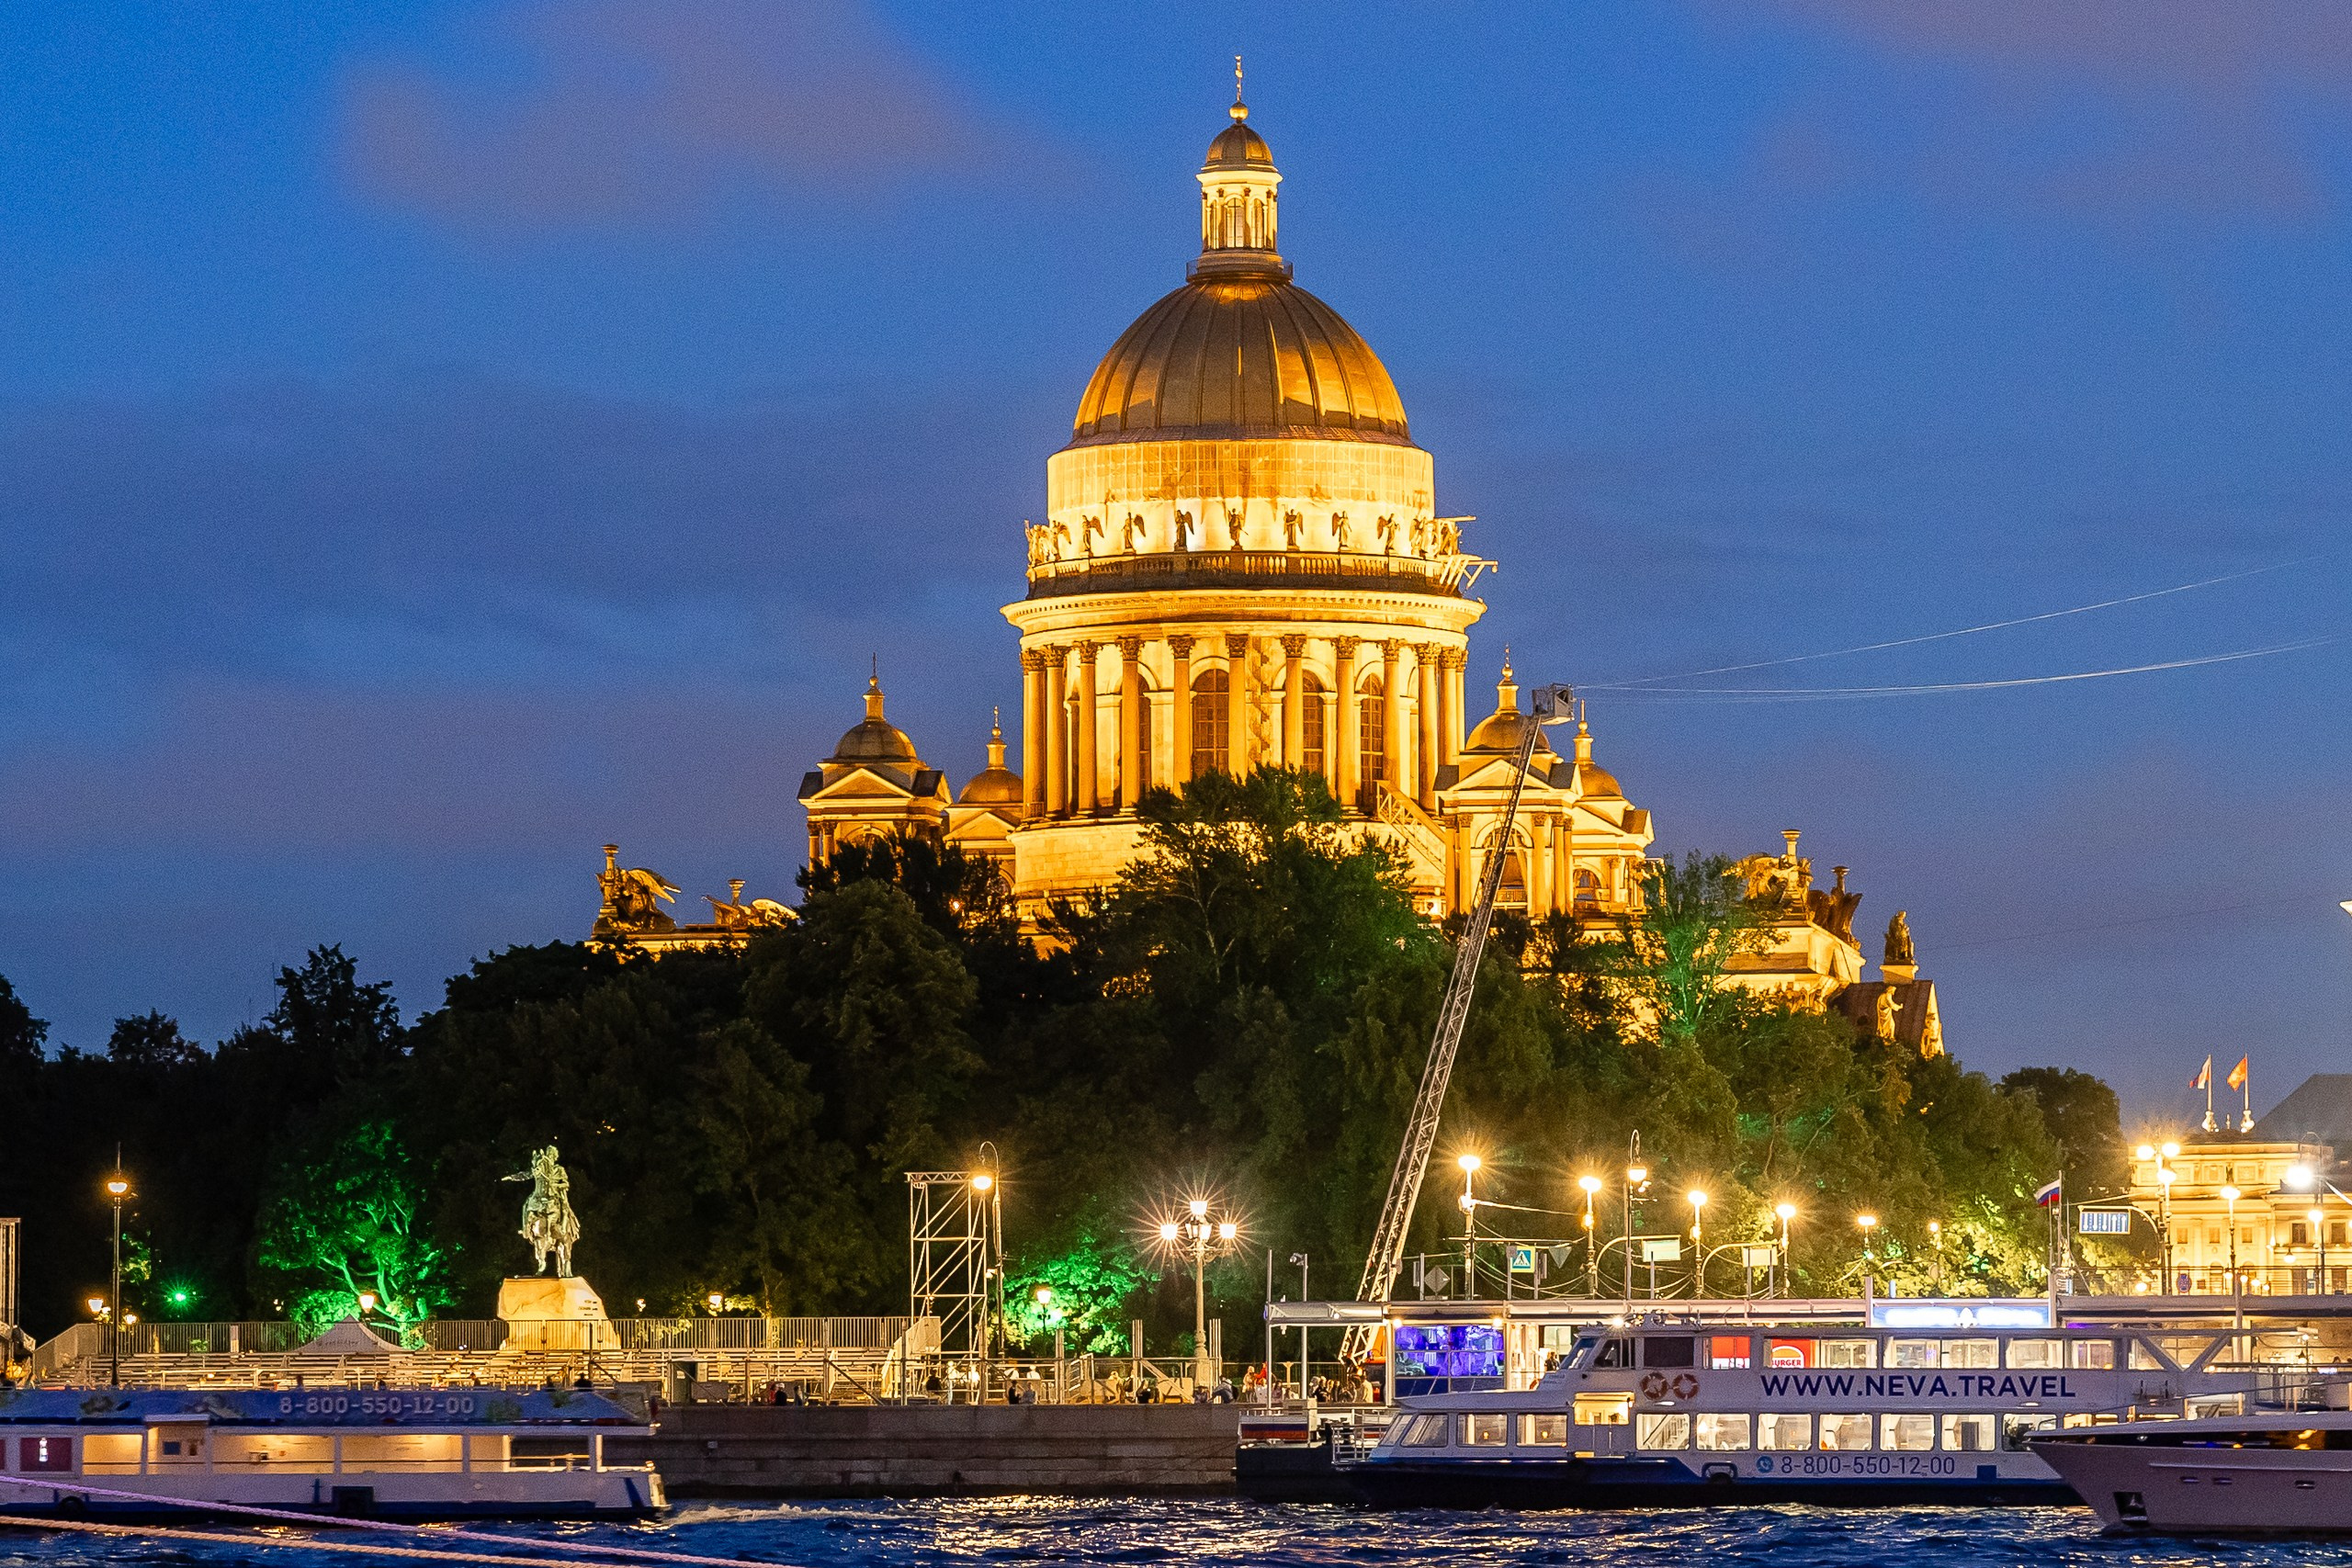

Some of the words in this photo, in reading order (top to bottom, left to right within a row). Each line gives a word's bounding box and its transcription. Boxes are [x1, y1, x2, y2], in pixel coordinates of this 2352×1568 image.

[1760, 1375, 2076, 1397] WWW.NEVA.TRAVEL
[279, 1396, 474, 1414] 8-800-550-12-00
[1781, 1456, 1956, 1475] 8-800-550-12-00
